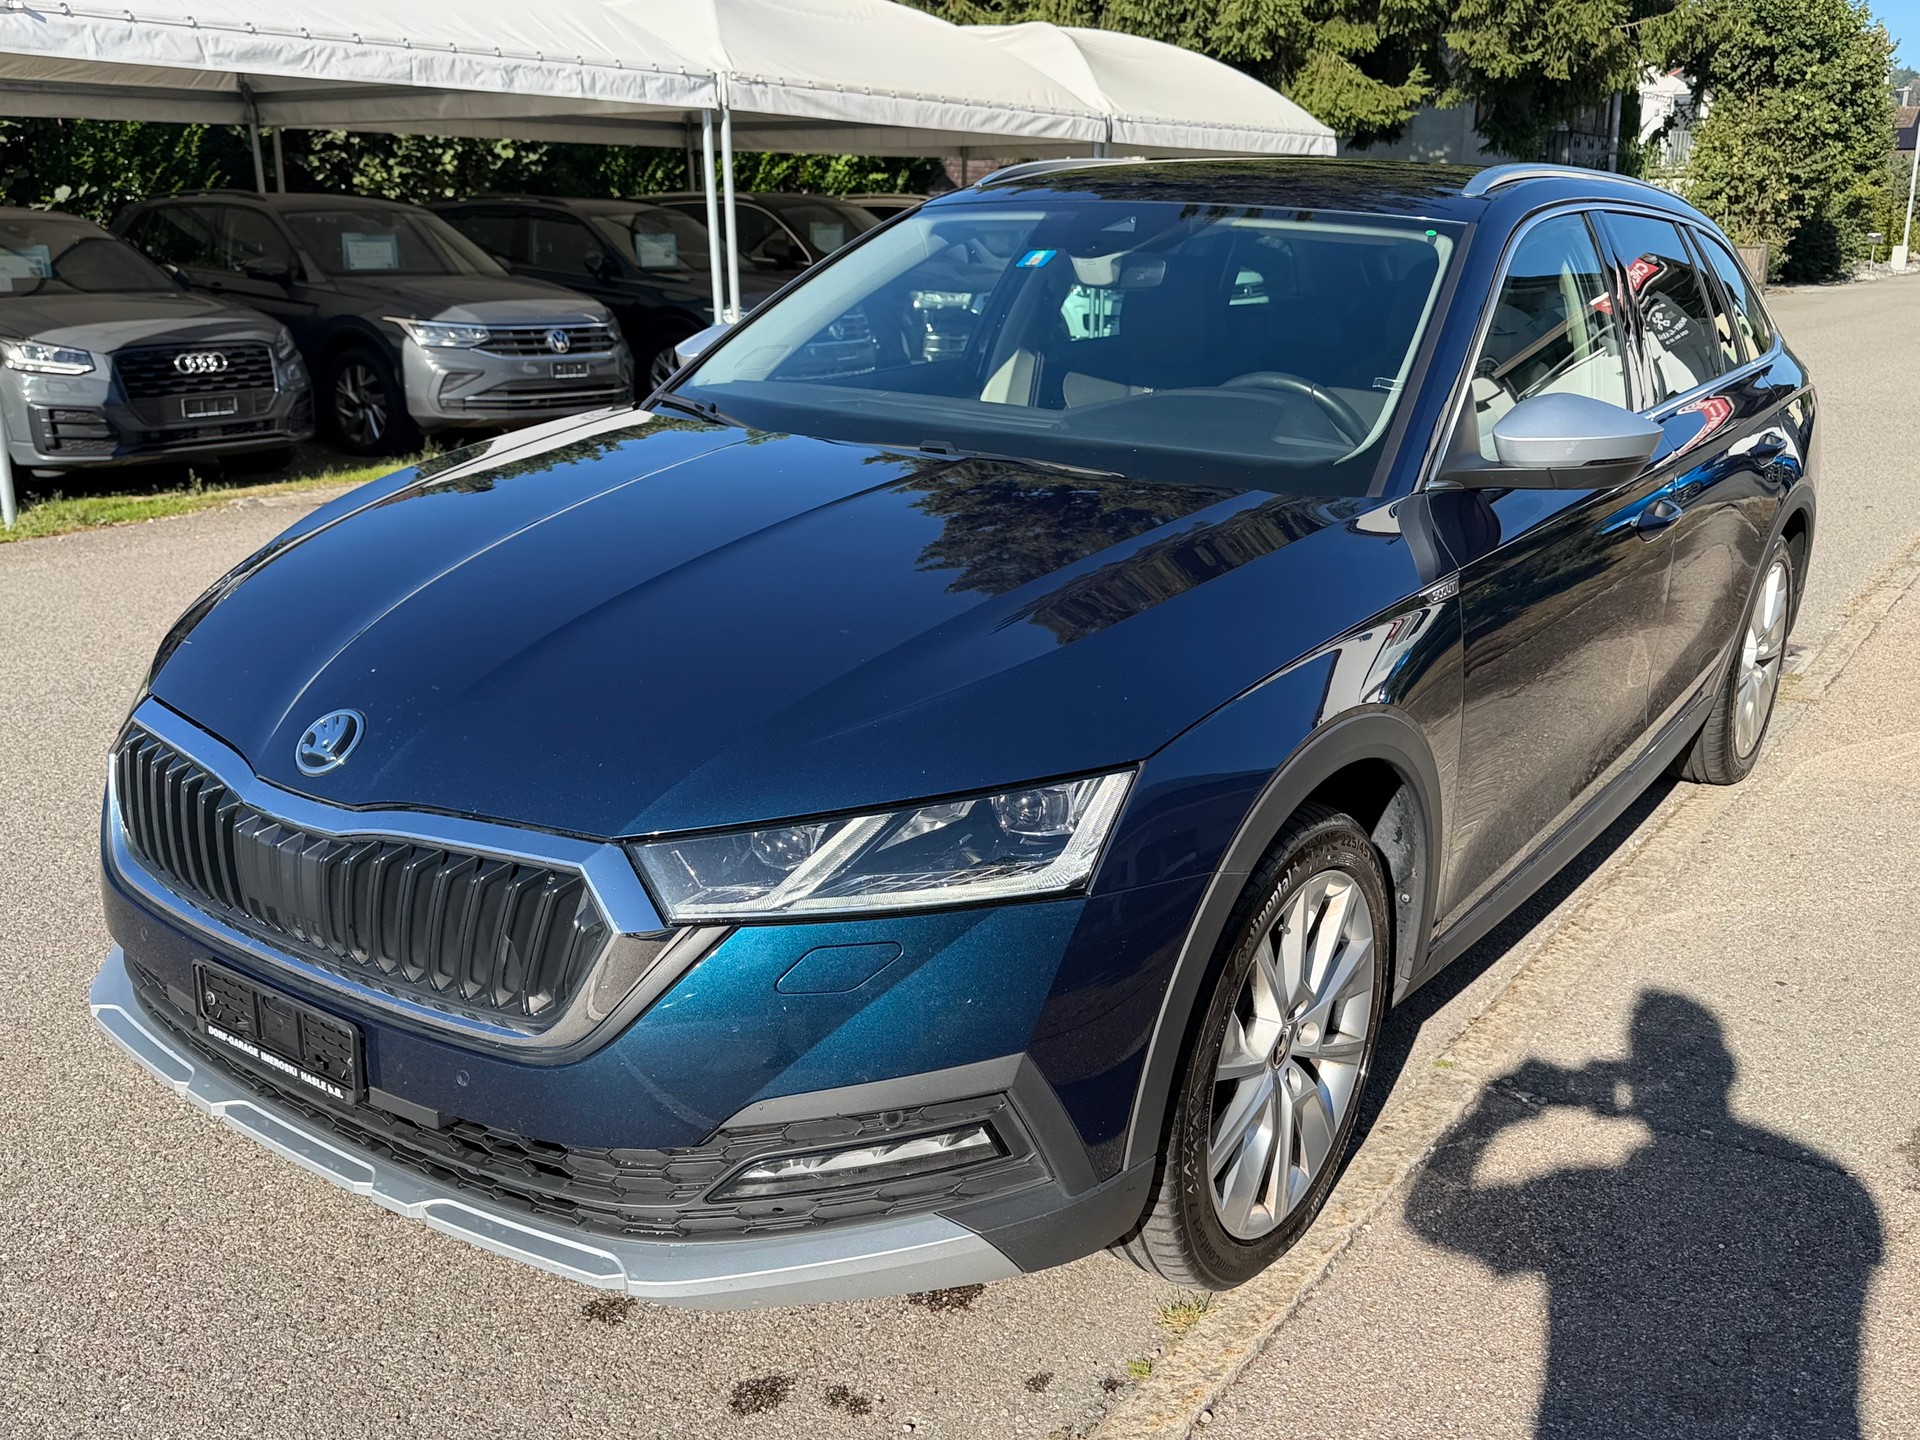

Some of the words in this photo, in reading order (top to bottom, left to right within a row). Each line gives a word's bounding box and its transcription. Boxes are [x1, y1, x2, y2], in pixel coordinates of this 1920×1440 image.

[1340, 834, 1369, 858] 225/45
[1234, 867, 1292, 971] Continental
[207, 1025, 259, 1058] DORF-GARAGE
[260, 1051, 298, 1077] IMEROSKI
[300, 1071, 327, 1092] HASLE
